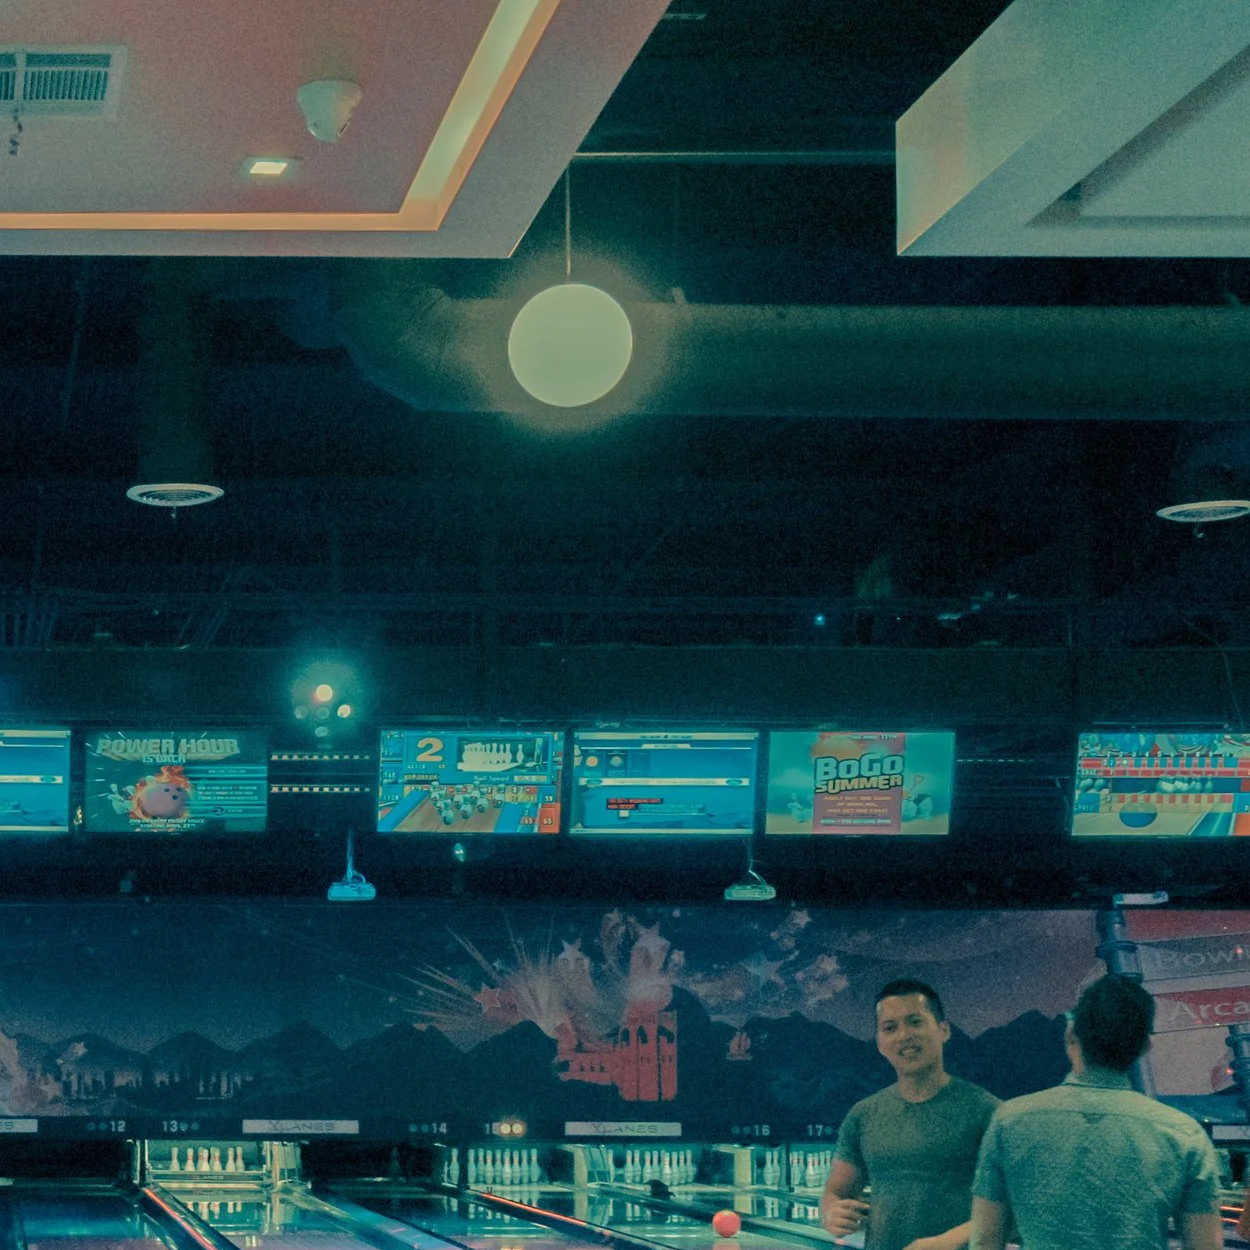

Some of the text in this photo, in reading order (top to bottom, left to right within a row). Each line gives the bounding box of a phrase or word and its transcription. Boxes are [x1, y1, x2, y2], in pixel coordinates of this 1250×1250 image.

[96, 738, 240, 755] POWER HOUR
[417, 737, 444, 762] 2
[815, 775, 903, 794] SUMMER
[111, 1120, 126, 1132] 12
[162, 1120, 178, 1132] 13
[269, 1120, 335, 1131] XLANES
[432, 1122, 447, 1134] 14
[591, 1122, 658, 1134] XLANES
[753, 1124, 770, 1136] 16
[807, 1124, 823, 1136] 17
